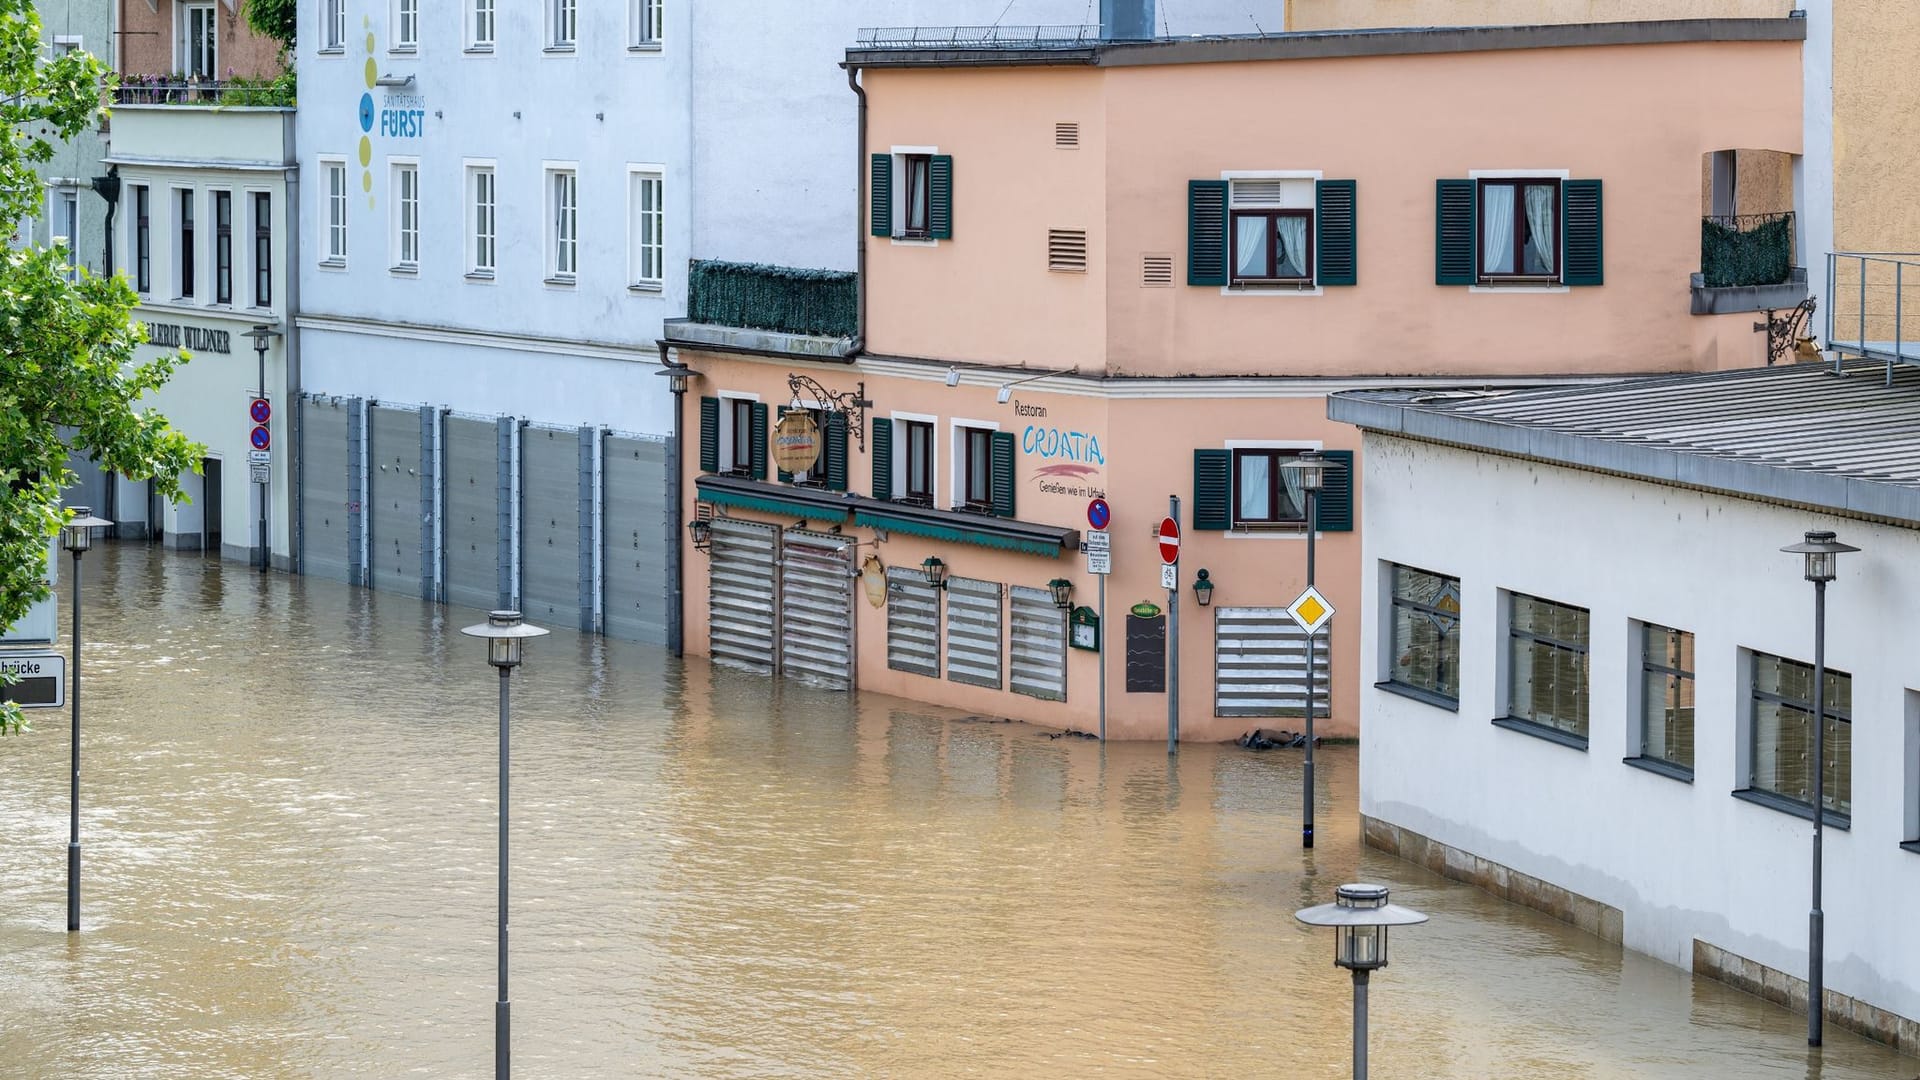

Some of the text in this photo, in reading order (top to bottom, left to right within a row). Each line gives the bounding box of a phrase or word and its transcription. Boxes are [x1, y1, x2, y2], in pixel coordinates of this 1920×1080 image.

[381, 109, 425, 138] FÜRST
[147, 322, 231, 354] LERIE WILDNER
[1014, 399, 1047, 417] Restoran
[1039, 480, 1066, 495] Genießen
[1067, 485, 1078, 496] wie
